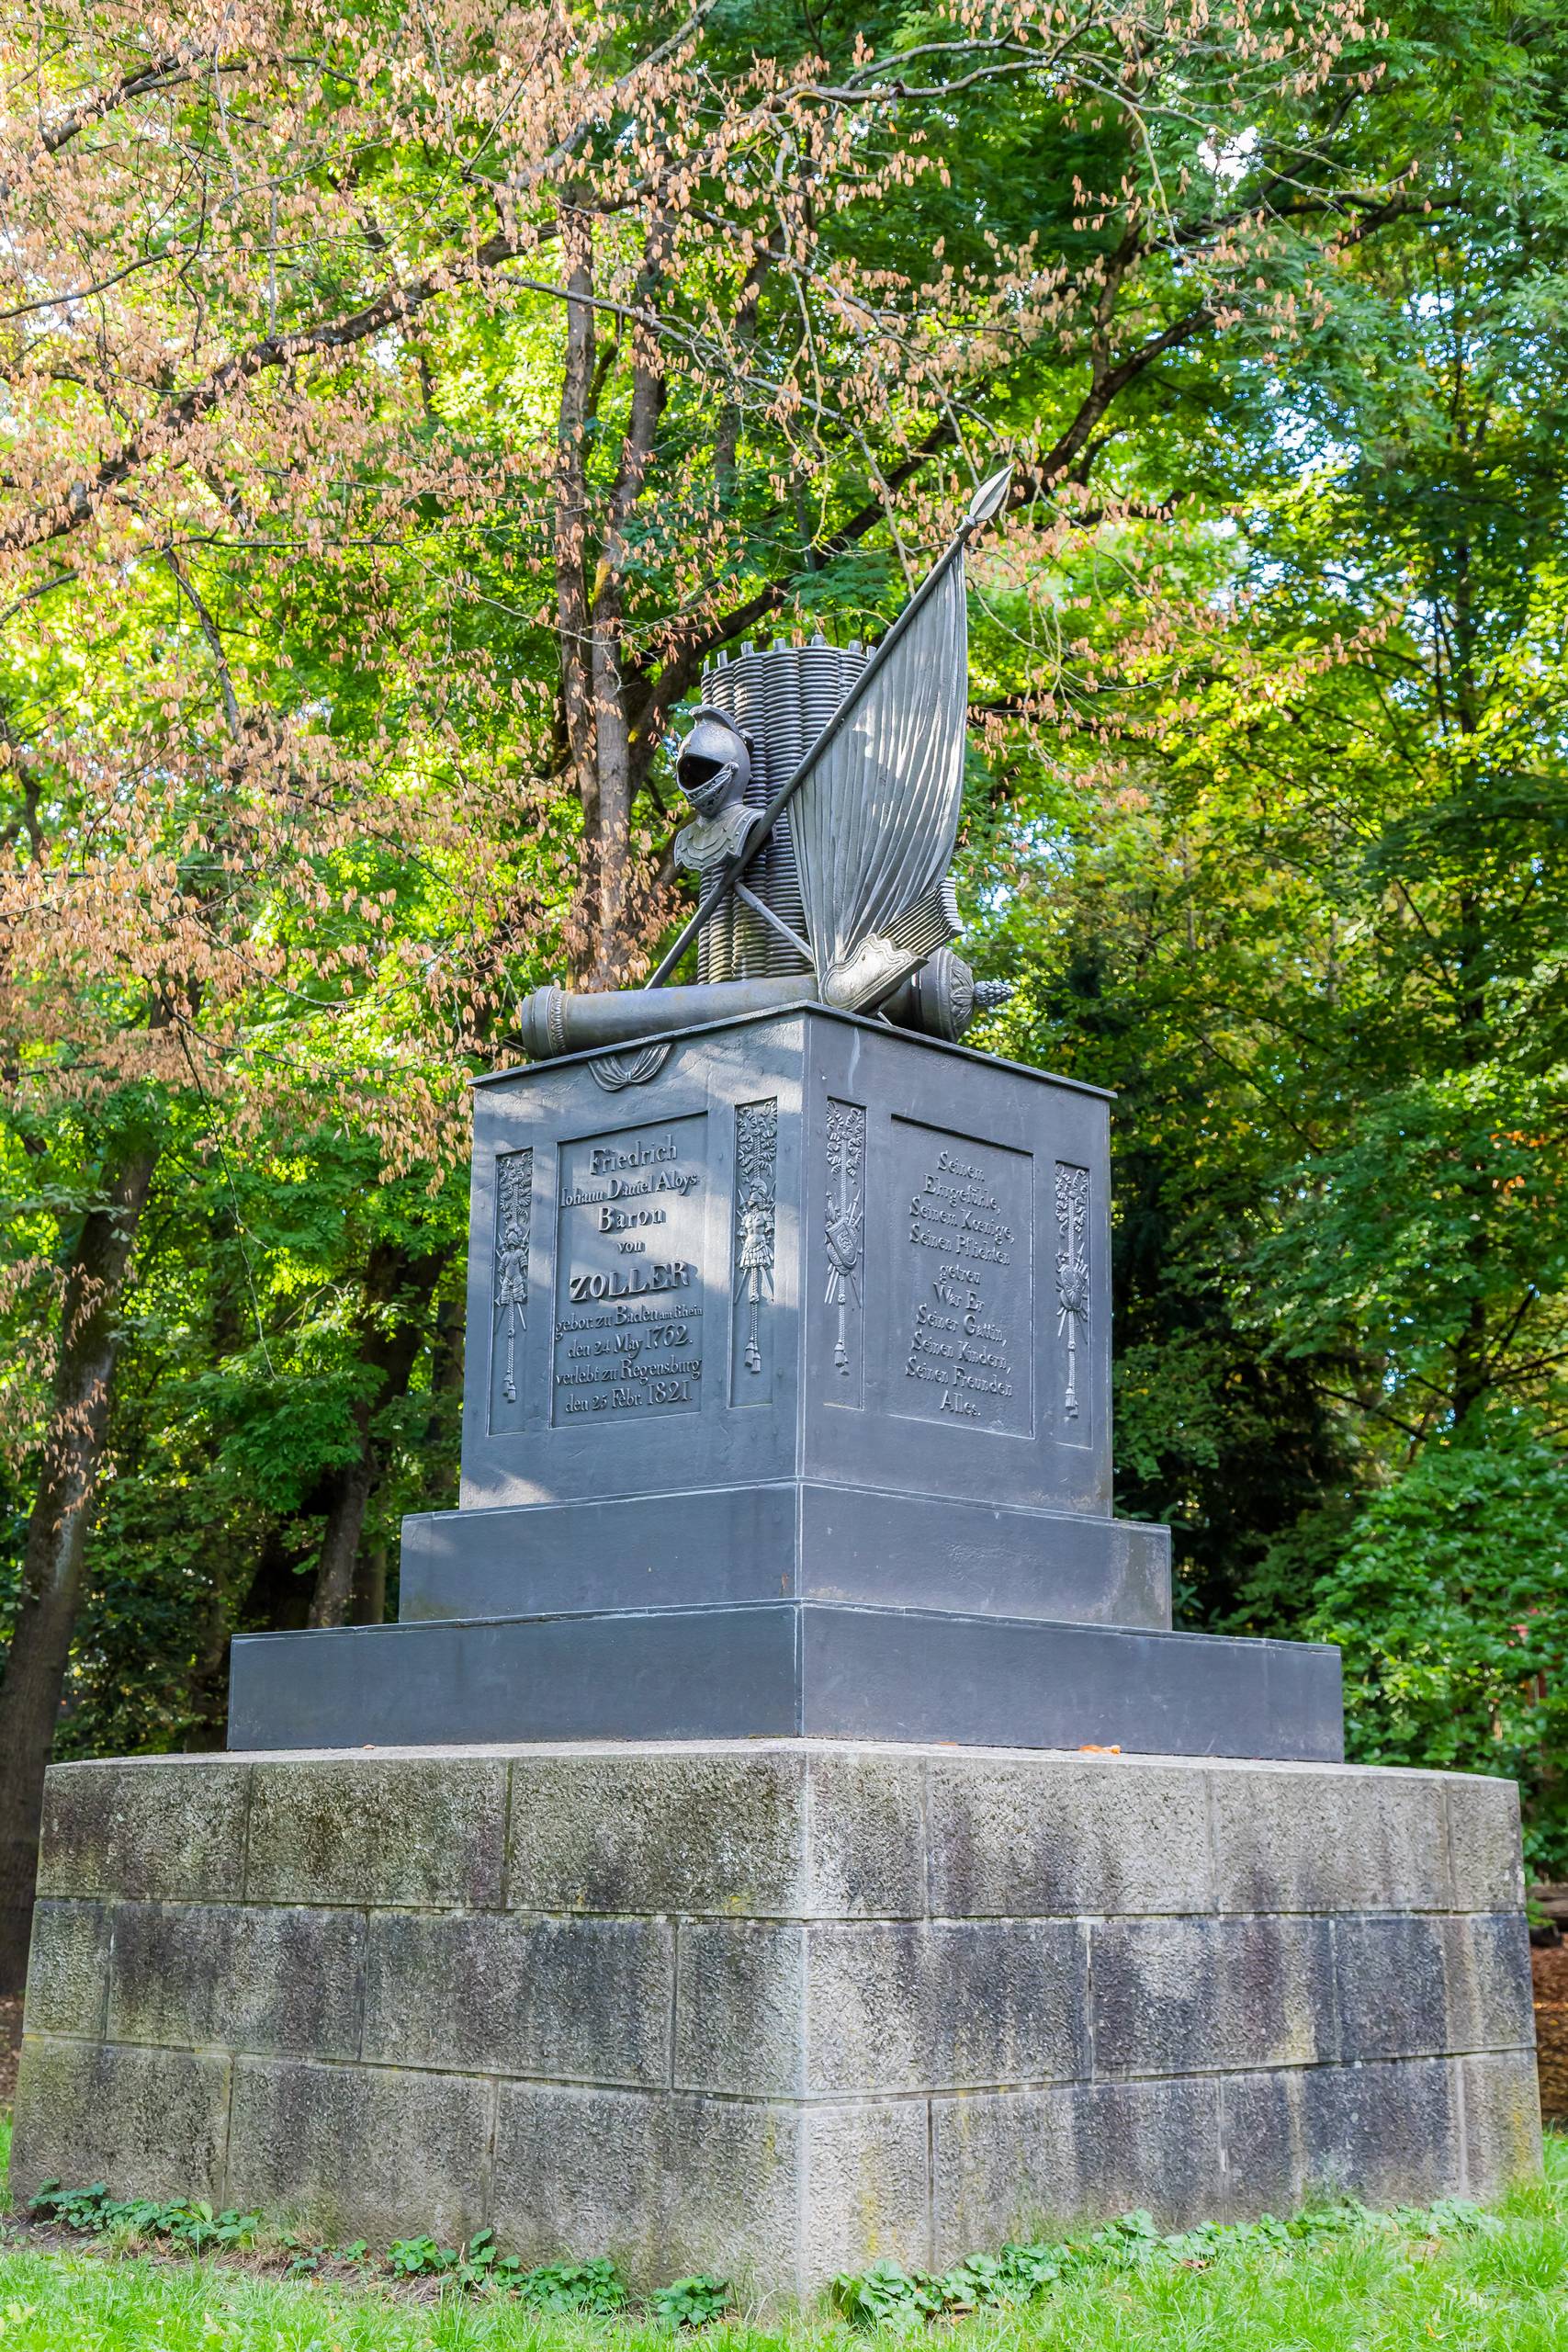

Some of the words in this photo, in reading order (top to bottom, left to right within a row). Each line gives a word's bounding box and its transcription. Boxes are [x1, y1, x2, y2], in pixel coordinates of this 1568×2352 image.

[589, 1134, 677, 1175] Friedrich
[937, 1150, 985, 1182] Seinem
[608, 1174, 653, 1200] Daniel
[598, 1206, 663, 1232] Baron
[909, 1194, 958, 1227] Seinem
[617, 1241, 642, 1253] von
[909, 1222, 952, 1251] Seinen
[955, 1235, 1010, 1265] Pflichten
[570, 1261, 690, 1302] ZOLLER
[933, 1282, 962, 1307] War
[965, 1290, 985, 1312] Er
[595, 1315, 612, 1329] zu
[615, 1306, 659, 1326] Baden
[660, 1309, 673, 1320] am
[673, 1304, 703, 1318] Rhein
[916, 1303, 959, 1332] Seiner
[964, 1315, 1007, 1347] Gattin,
[569, 1339, 591, 1358] den
[594, 1340, 610, 1355] 24
[614, 1333, 643, 1359] May
[645, 1324, 693, 1350] 1762.
[911, 1329, 954, 1358] Seinen
[957, 1341, 1011, 1374] Kindern,
[555, 1364, 599, 1385] verlebt
[601, 1370, 617, 1382] zu
[621, 1354, 702, 1385] Regensburg
[905, 1355, 949, 1384] Seinen
[953, 1366, 1012, 1396] Freunden
[566, 1394, 589, 1412] den
[612, 1388, 643, 1408] Febr.
[648, 1380, 693, 1405] 1821.
[940, 1390, 981, 1416] Alles.
